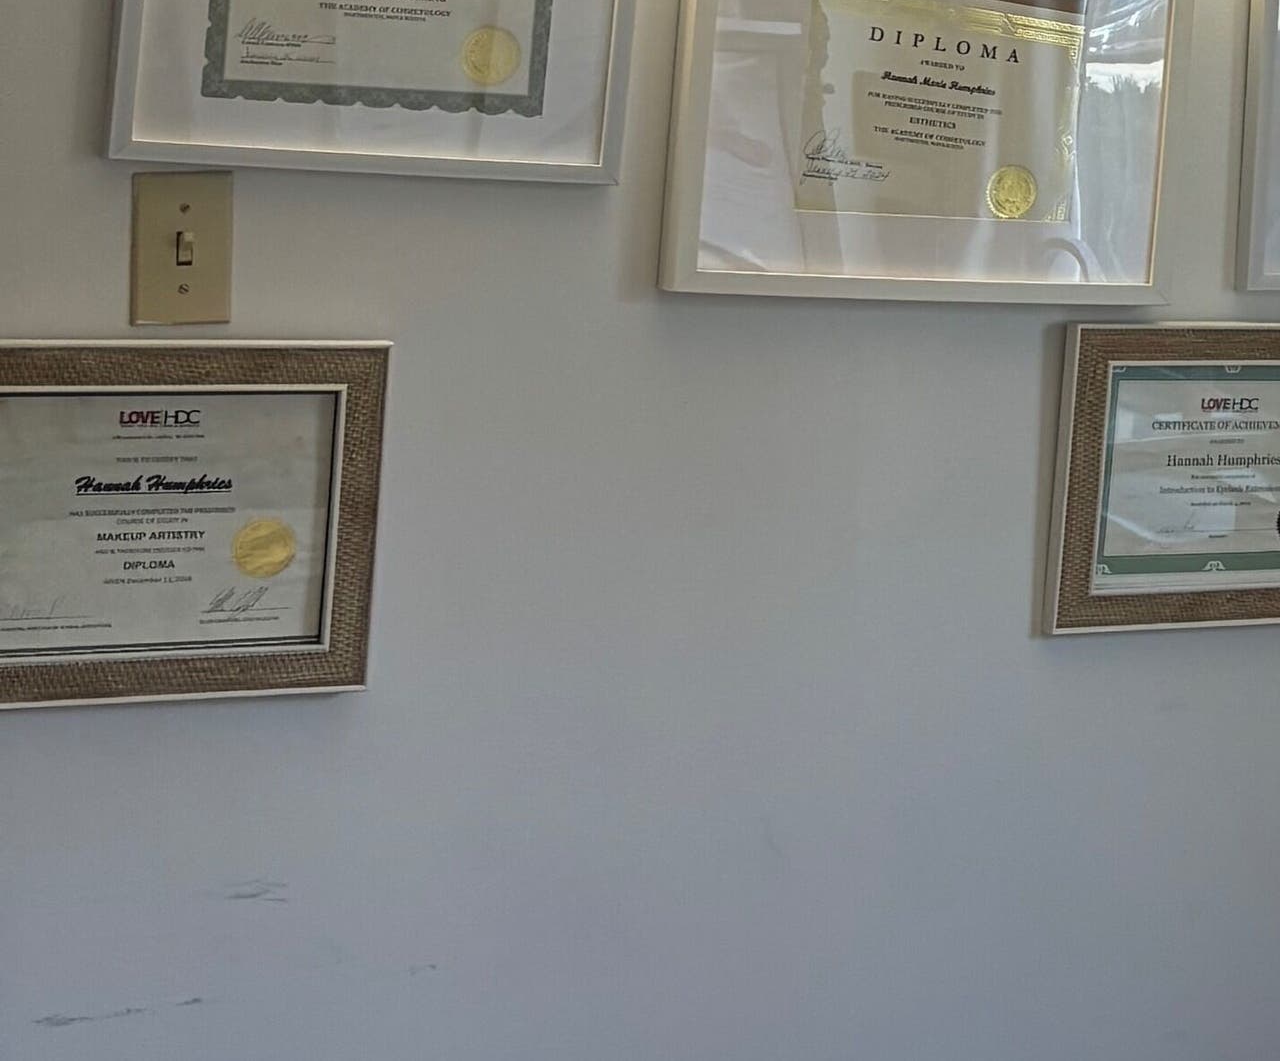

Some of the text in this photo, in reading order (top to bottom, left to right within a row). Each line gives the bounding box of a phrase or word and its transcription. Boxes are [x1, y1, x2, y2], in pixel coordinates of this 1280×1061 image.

[870, 26, 1020, 63] DIPLOMA
[1152, 420, 1216, 431] CERTIFICATE
[1217, 421, 1232, 430] OF
[1167, 454, 1214, 466] Hannah
[74, 475, 142, 493] Hannah
[96, 530, 206, 542] MAKEUP ARTISTRY
[123, 560, 175, 570] DIPLOMA
